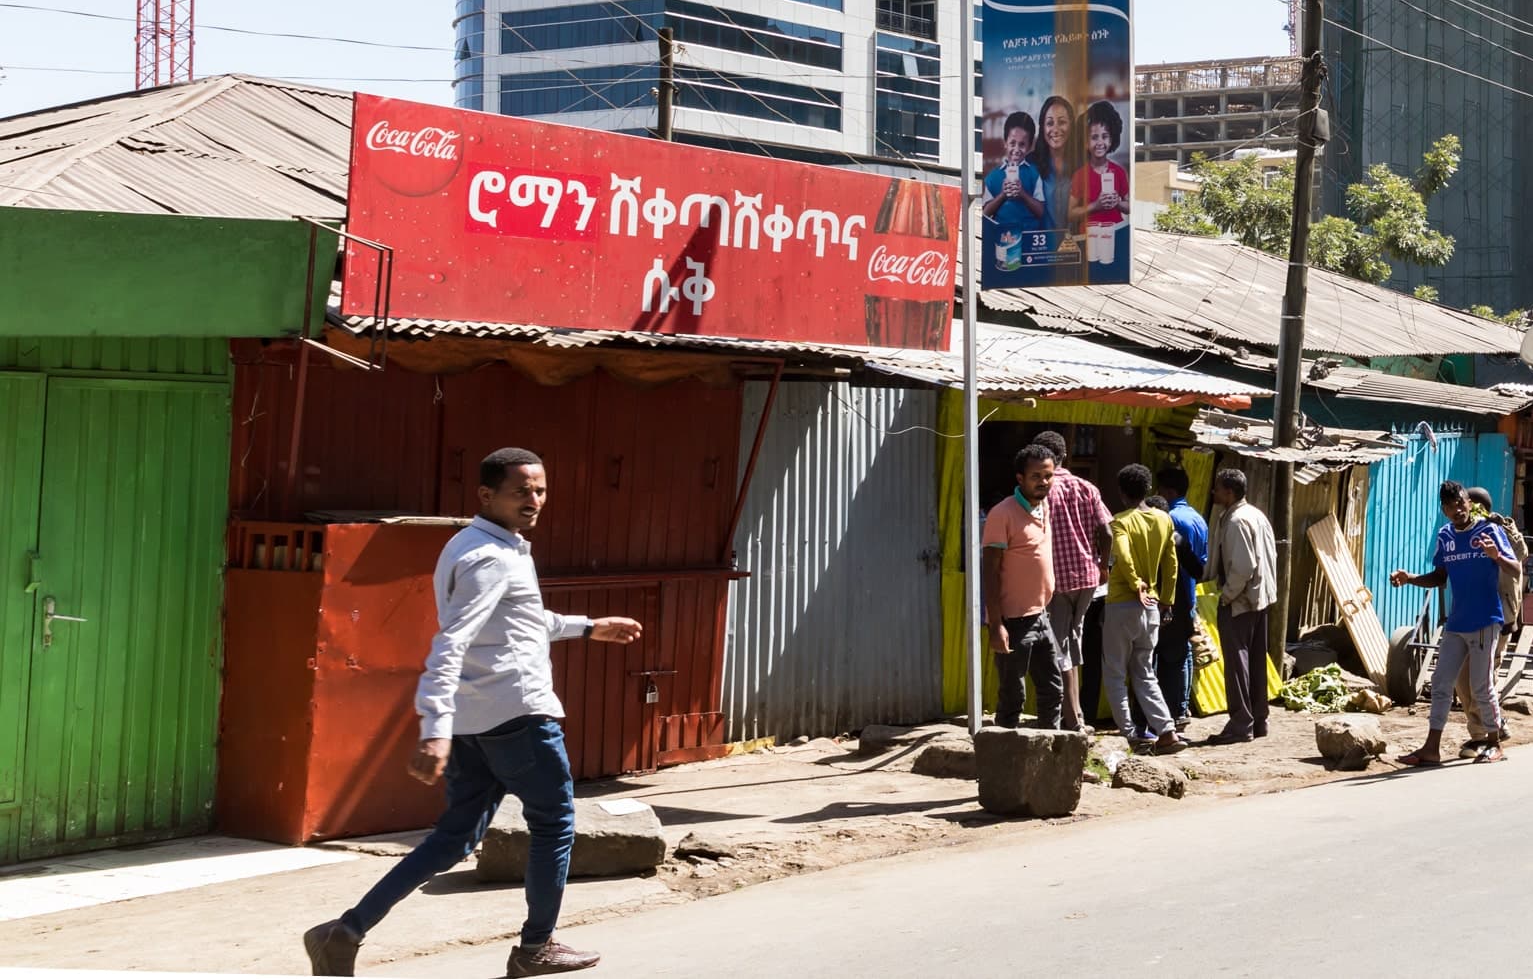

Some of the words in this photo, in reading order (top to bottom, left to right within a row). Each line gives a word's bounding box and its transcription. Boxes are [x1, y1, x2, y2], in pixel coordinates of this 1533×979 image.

[366, 120, 460, 159] Coca-Cola
[468, 170, 597, 231] ሮማን
[1032, 234, 1047, 246] 33
[641, 256, 716, 316] ሱቅ
[868, 245, 949, 287] Coca-Cola
[1445, 540, 1456, 552] 10
